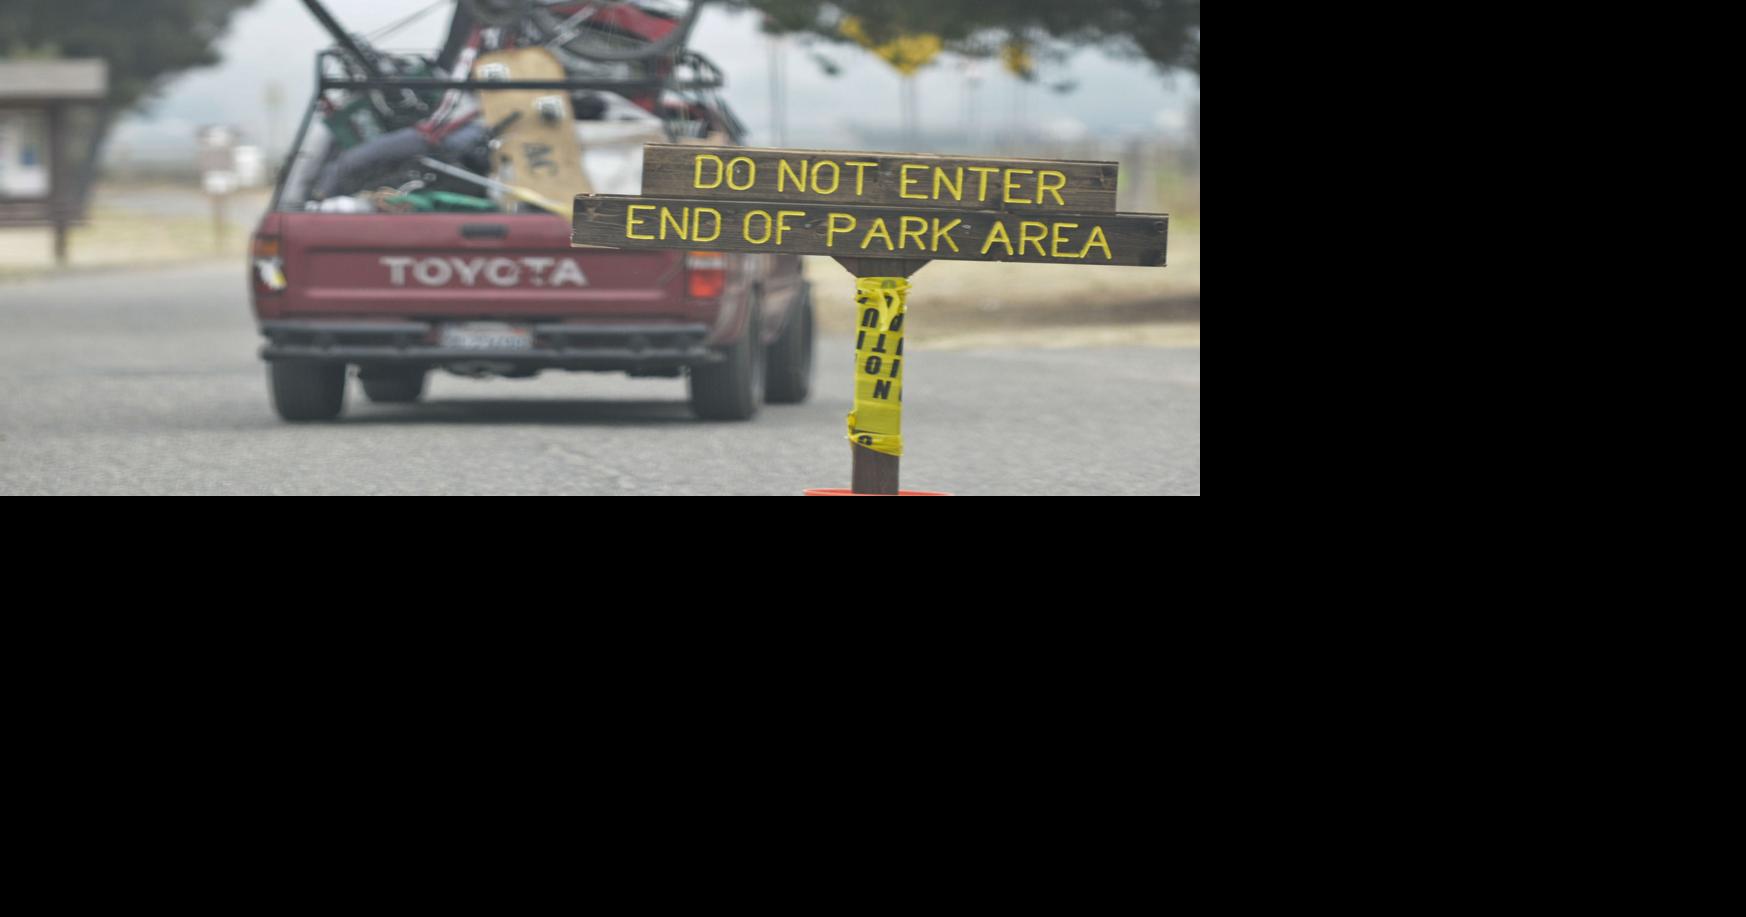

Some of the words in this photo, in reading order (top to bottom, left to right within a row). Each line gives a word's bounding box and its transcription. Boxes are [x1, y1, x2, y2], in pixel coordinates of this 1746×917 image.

[693, 152, 756, 191] DO
[777, 158, 880, 197] NOT
[898, 162, 1067, 206] ENTER
[625, 203, 722, 243] END
[741, 209, 807, 246] OF
[825, 212, 962, 253] PARK
[980, 219, 1113, 261] AREA
[379, 256, 589, 288] TOYOTA
